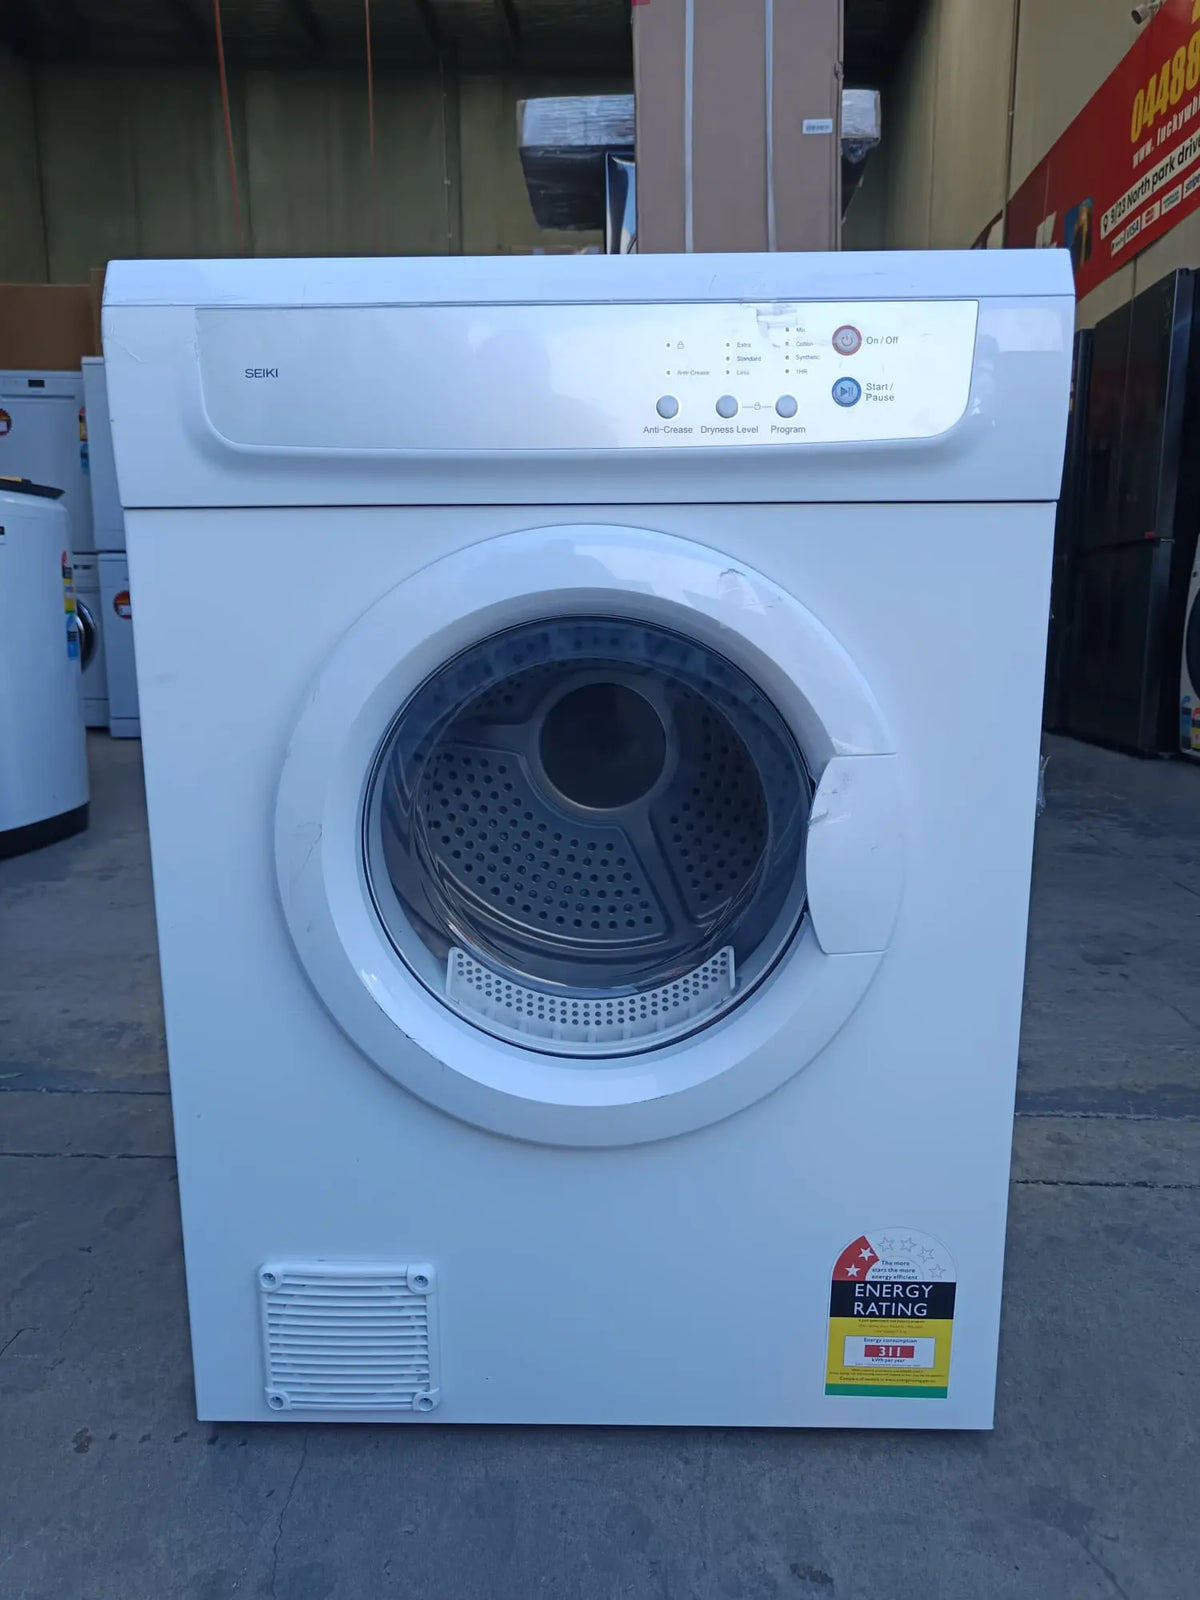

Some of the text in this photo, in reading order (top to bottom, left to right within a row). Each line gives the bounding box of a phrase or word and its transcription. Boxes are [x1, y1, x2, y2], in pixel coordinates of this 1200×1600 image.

[1111, 197, 1126, 225] 9/23
[1127, 176, 1150, 209] North
[1152, 155, 1175, 192] park
[1126, 219, 1139, 239] VISA
[866, 336, 879, 345] On
[885, 336, 899, 345] Off
[795, 354, 821, 362] Synthetic
[244, 368, 279, 378] SEIKI
[866, 382, 888, 391] Start
[865, 393, 895, 402] Pause
[643, 425, 693, 434] Anti-Crease
[700, 425, 759, 436] Dryness Level
[770, 425, 806, 436] Program
[854, 1283, 934, 1299] ENERGY
[853, 1302, 928, 1317] RATING
[878, 1346, 901, 1357] 311
